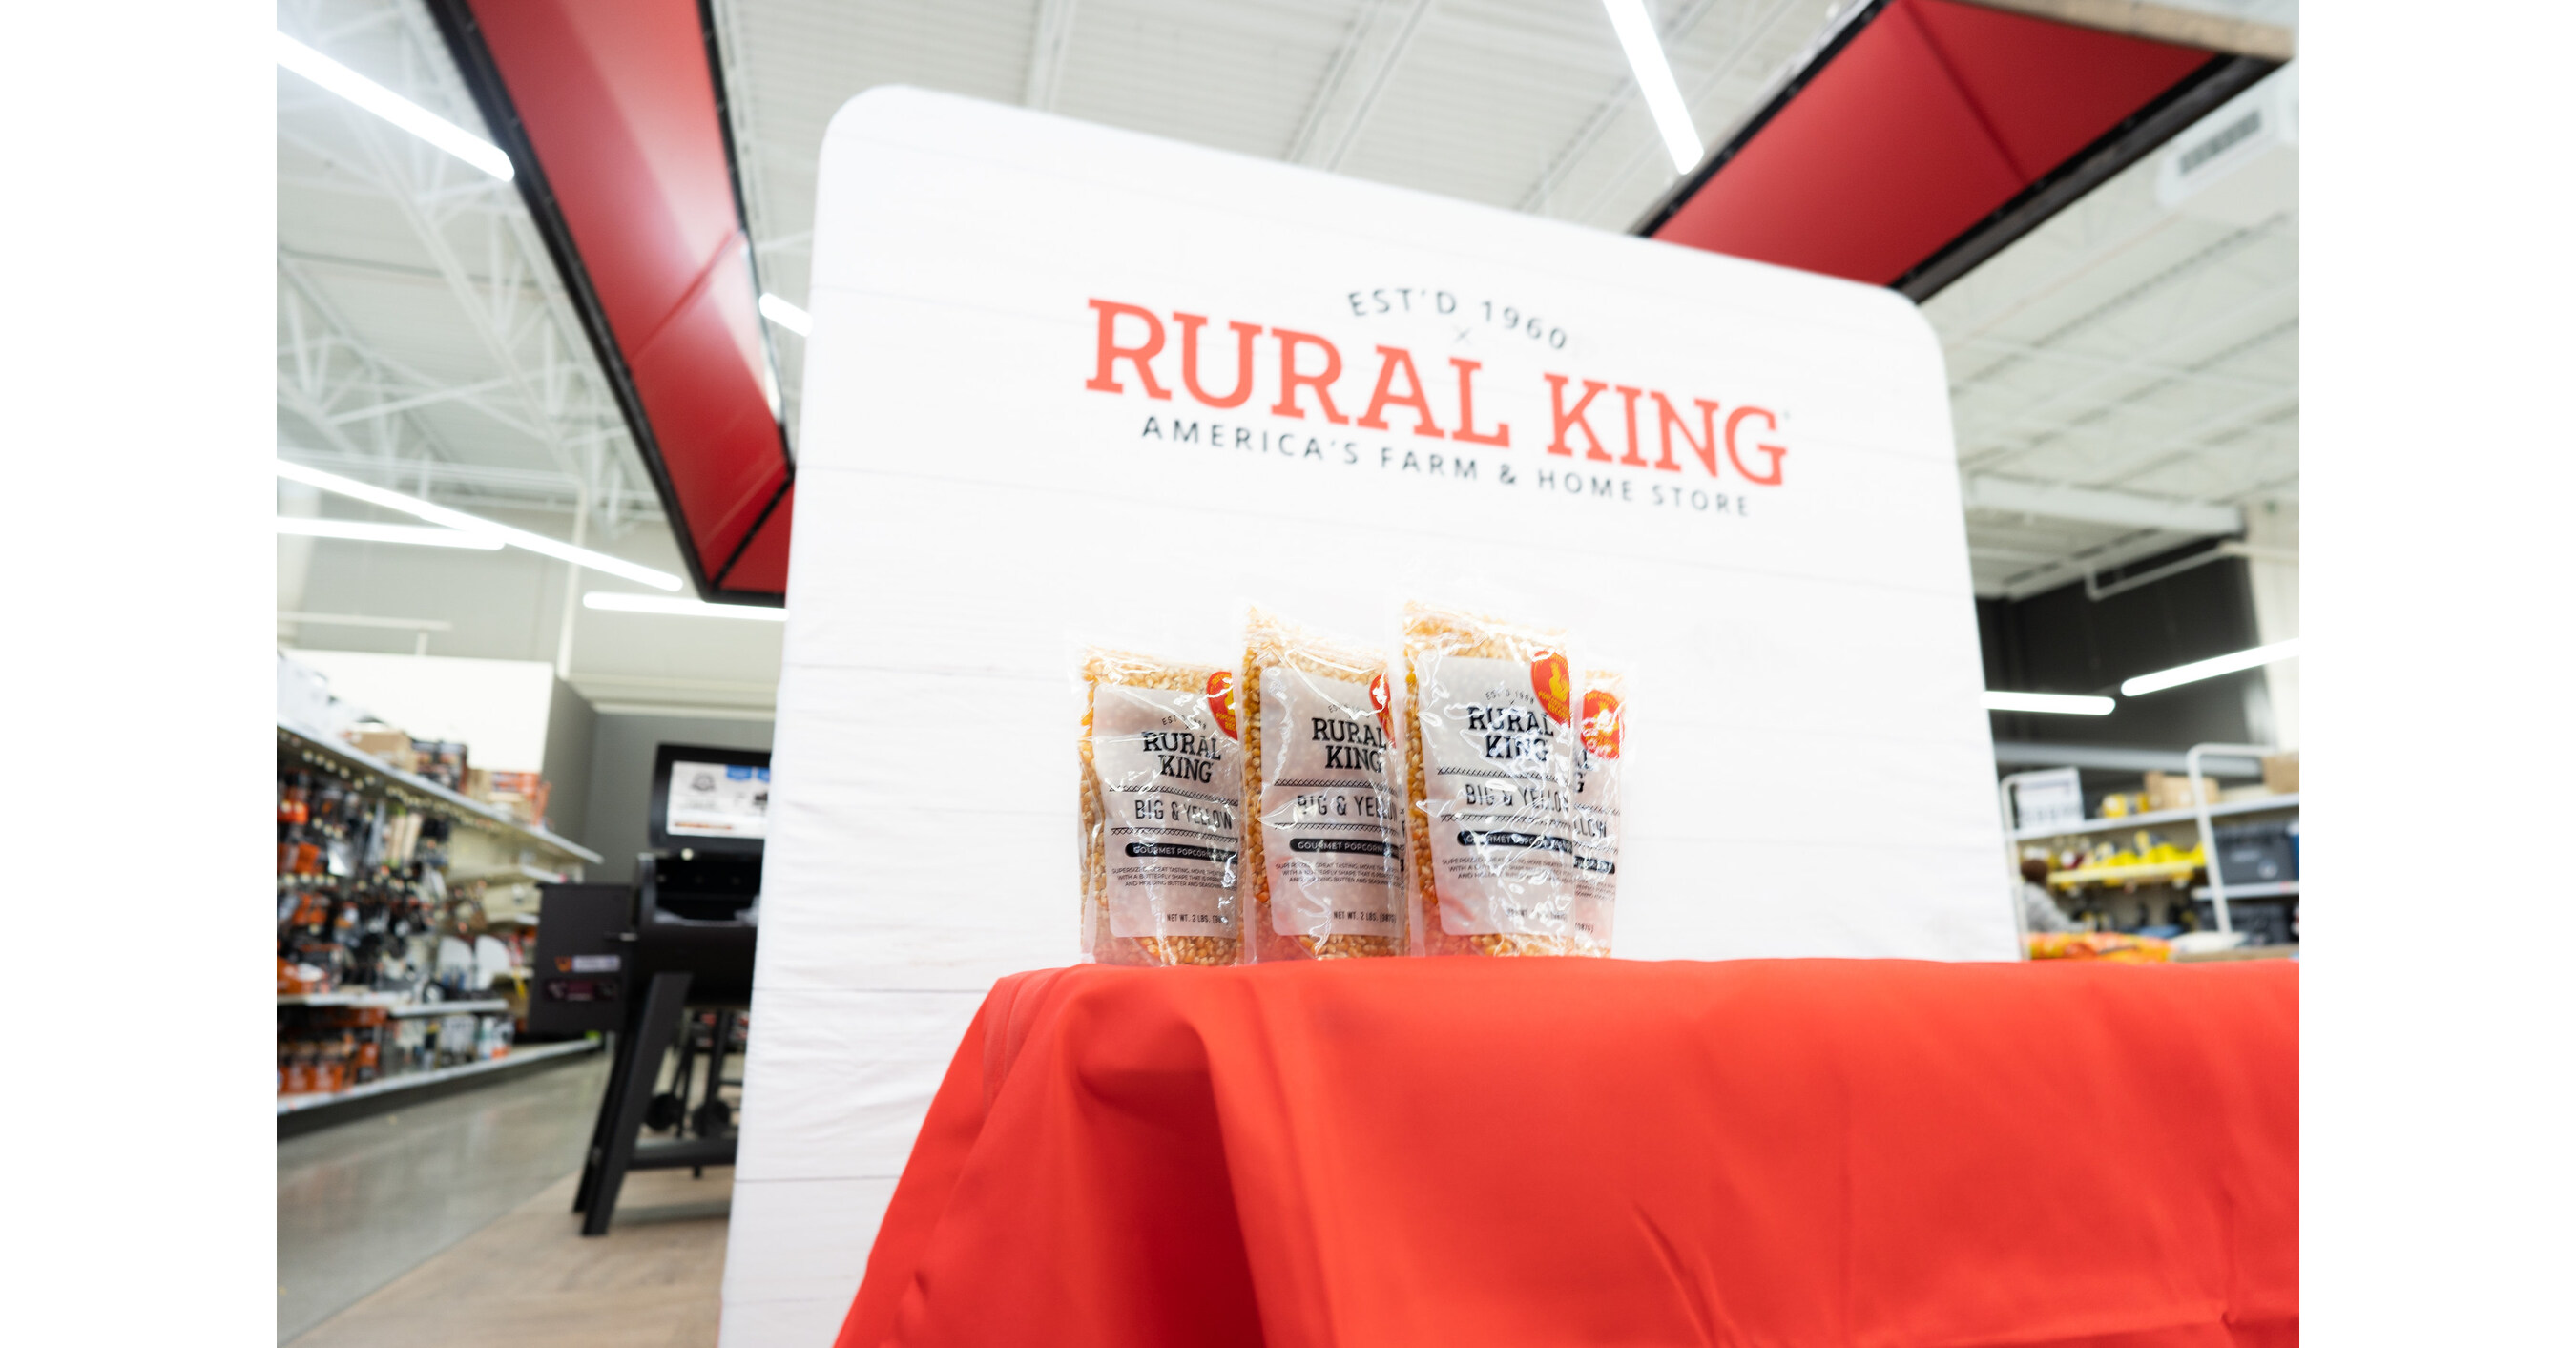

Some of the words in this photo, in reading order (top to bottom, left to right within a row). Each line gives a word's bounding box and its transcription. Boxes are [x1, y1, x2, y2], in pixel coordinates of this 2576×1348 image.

[1347, 287, 1457, 318] EST'D
[1481, 300, 1568, 351] 1960
[1085, 298, 1510, 448] RURAL
[1543, 372, 1787, 487] KING
[1141, 415, 1360, 466] AMERICA'S
[1381, 446, 1478, 481] FARM
[1499, 464, 1518, 486] &
[1537, 468, 1635, 502] HOME
[1651, 483, 1751, 518] STORE
[1311, 717, 1387, 750] RURAL
[1467, 706, 1554, 737] RURAL
[1142, 731, 1221, 761] RURAL
[1325, 745, 1381, 774] KING
[1485, 735, 1548, 762] KING
[1158, 754, 1213, 784] KING
[1134, 799, 1164, 820] BIG
[1171, 800, 1179, 821] &
[1336, 795, 1347, 816] &
[1132, 845, 1176, 856] GOURMET
[1298, 840, 1343, 850] GOURMET
[1344, 841, 1383, 853] POPCORN
[1167, 913, 1178, 923] NET
[1334, 911, 1345, 920] NET
